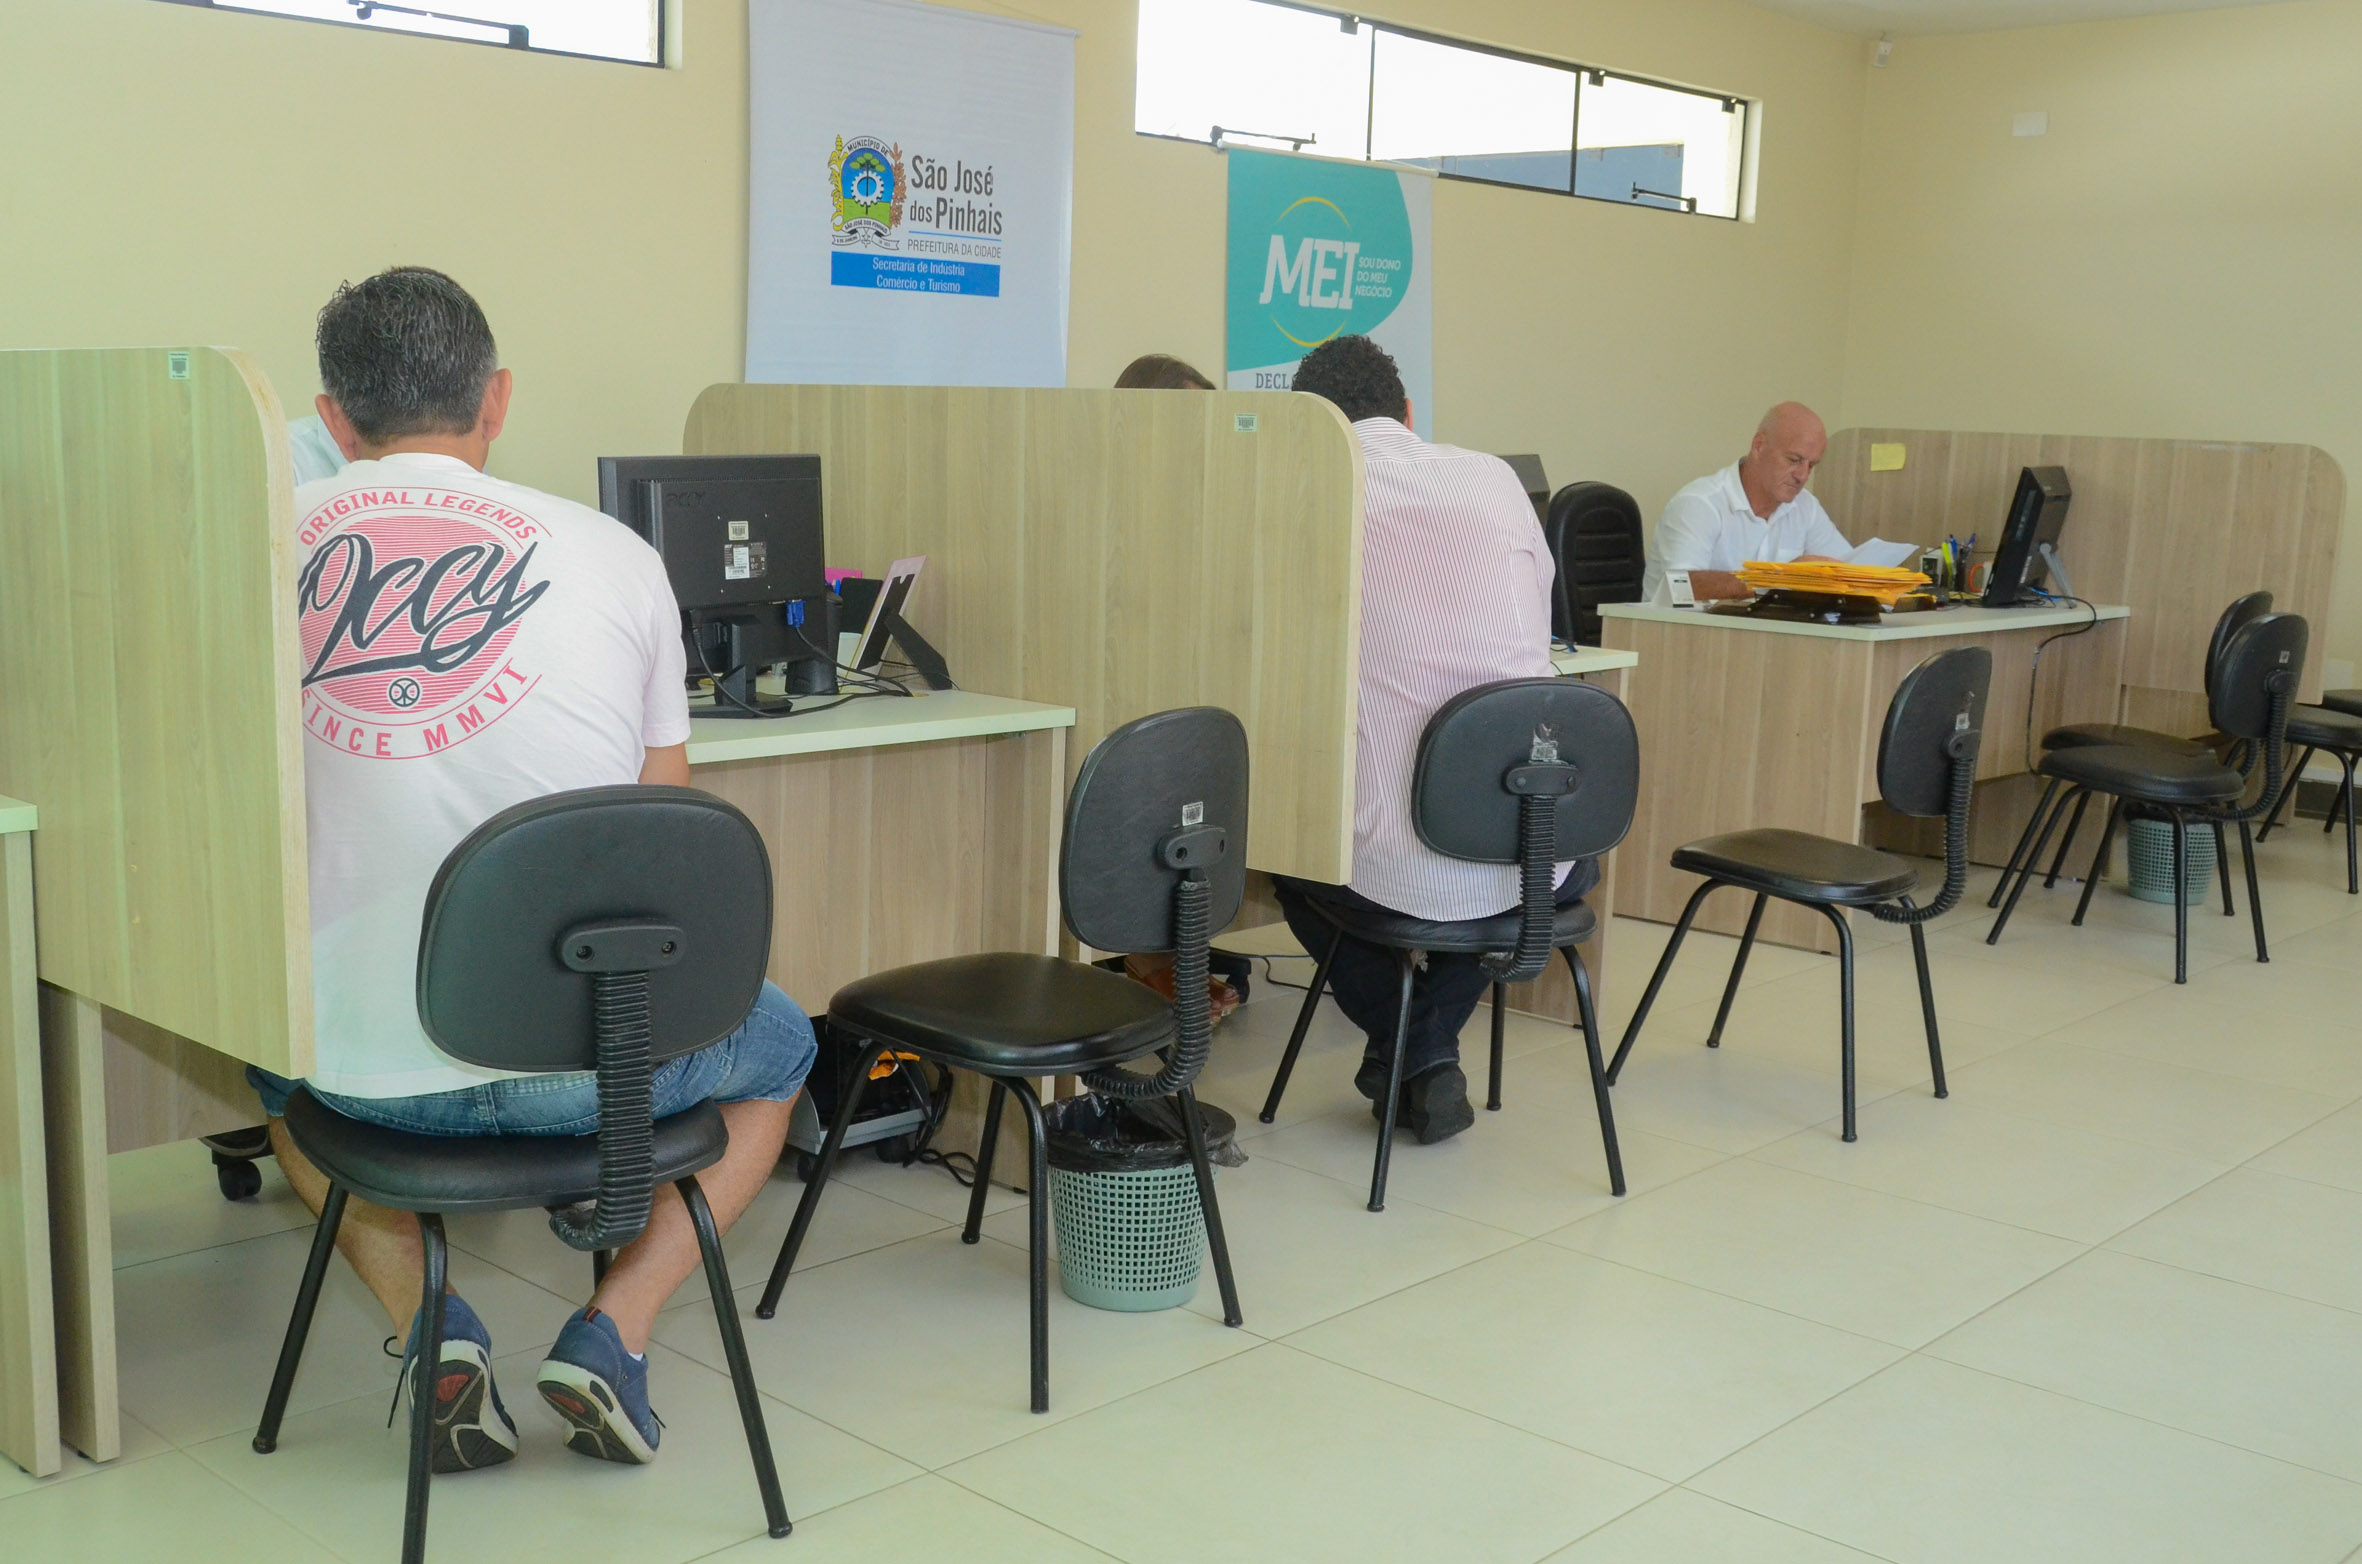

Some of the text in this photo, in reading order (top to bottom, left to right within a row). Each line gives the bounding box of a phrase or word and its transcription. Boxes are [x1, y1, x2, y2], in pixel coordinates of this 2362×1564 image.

[847, 138, 889, 156] MUNICÍPIO DE
[911, 155, 993, 197] São José
[910, 197, 1002, 235] dos Pinhais
[907, 239, 959, 255] PREFEITURA
[961, 244, 972, 255] DA
[974, 245, 1001, 258] CIDADE
[872, 257, 965, 276] Secretaria de Indústria
[1259, 234, 1361, 310] MEI
[1359, 256, 1401, 271] SOU DONO
[876, 274, 961, 293] Comércio e Turismo
[1357, 270, 1388, 284] DO MEU
[1255, 372, 1292, 390] DECL
[300, 491, 537, 546] ORIGINAL LEGENDS
[422, 665, 528, 752] MMVI
